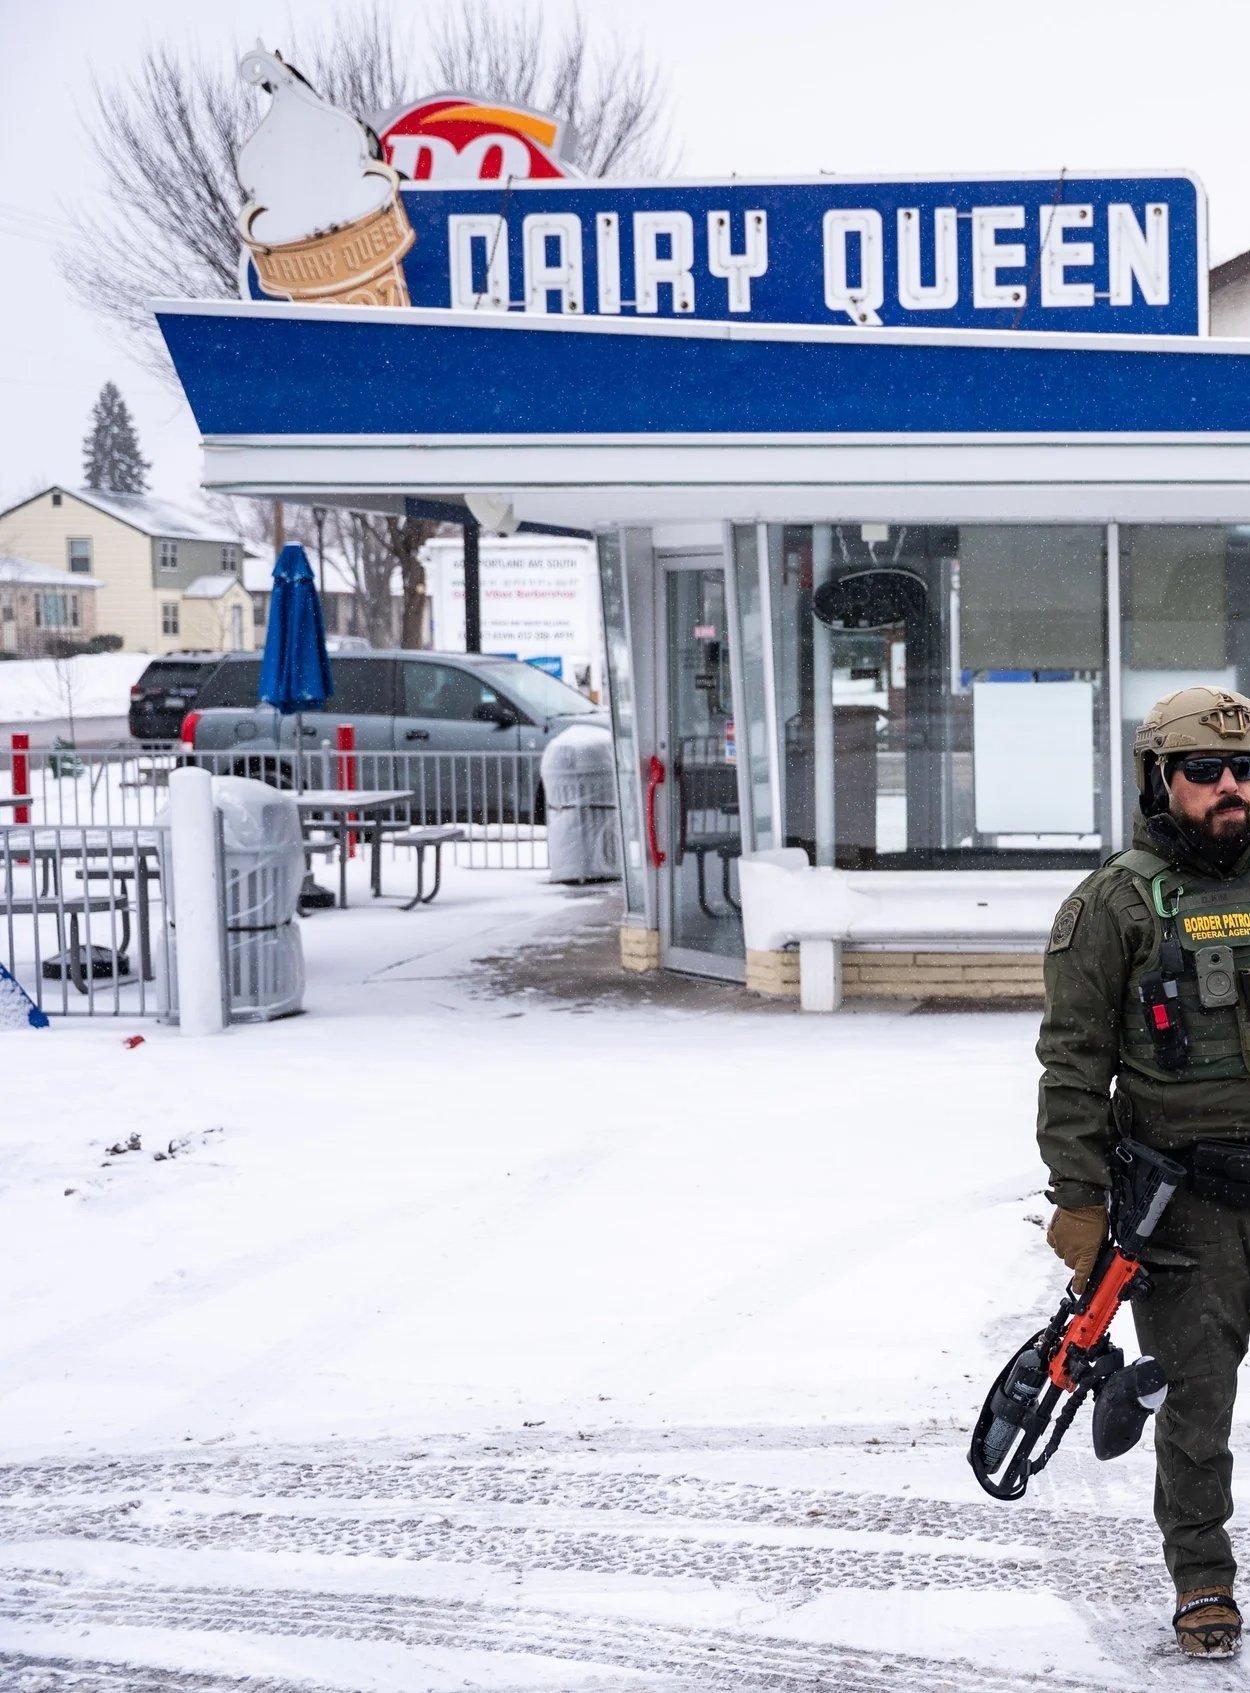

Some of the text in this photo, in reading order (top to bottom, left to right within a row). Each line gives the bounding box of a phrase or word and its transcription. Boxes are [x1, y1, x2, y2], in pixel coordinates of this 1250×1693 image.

[263, 250, 337, 282] DAIRY
[448, 203, 1169, 326] DAIRY QUEEN
[1184, 915, 1222, 932] BORDER
[1191, 930, 1228, 941] FEDERAL
